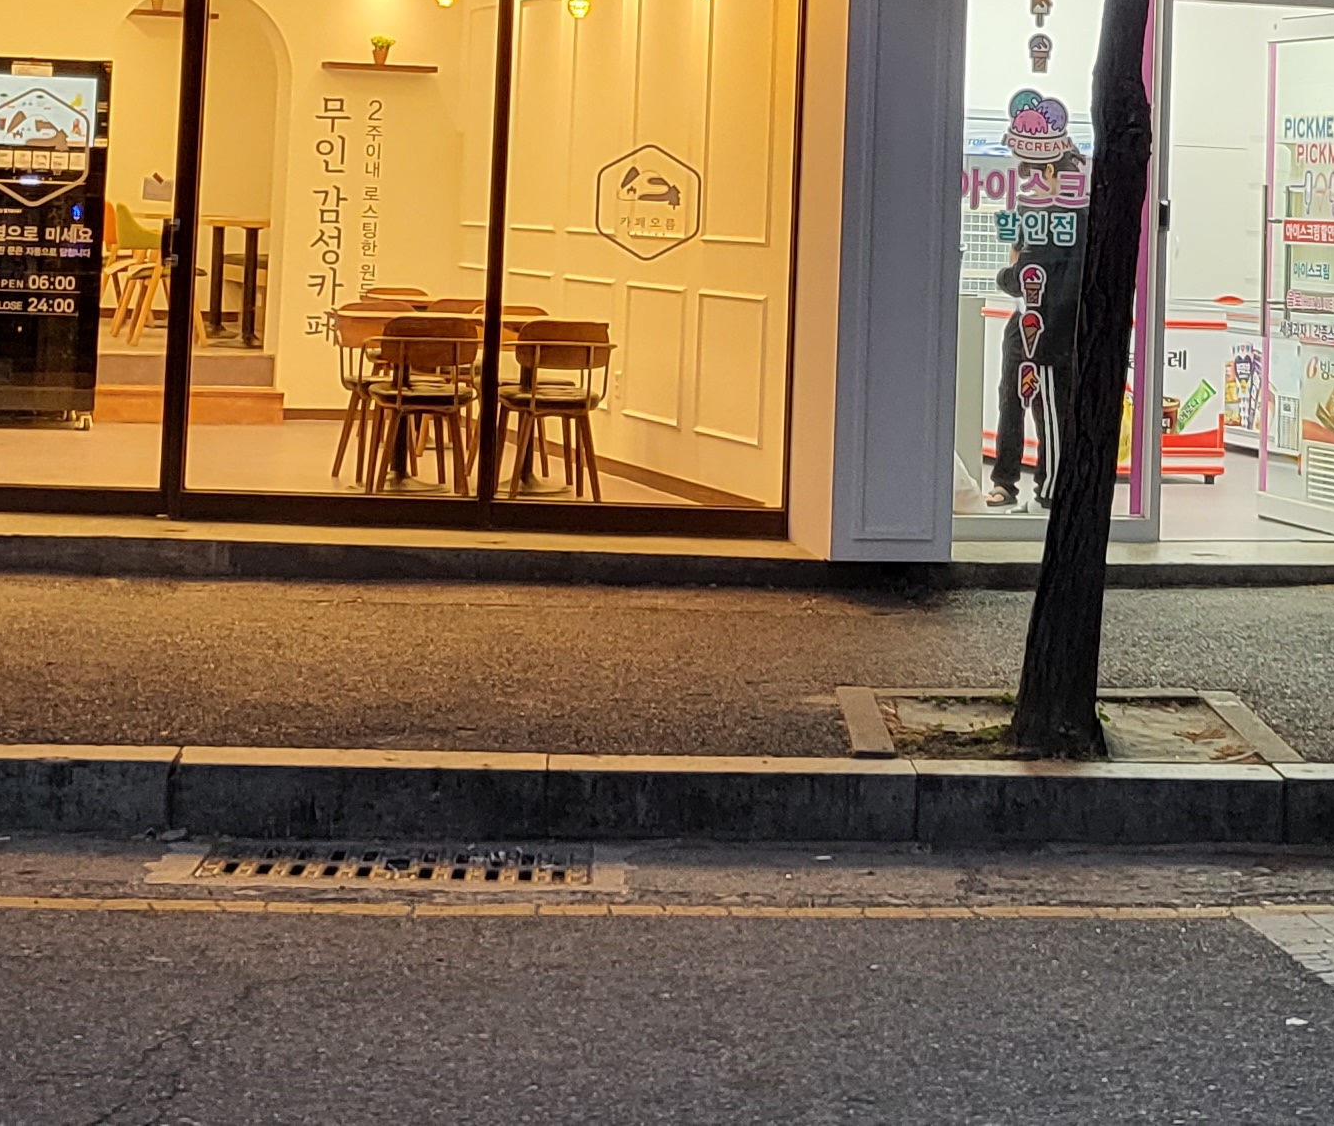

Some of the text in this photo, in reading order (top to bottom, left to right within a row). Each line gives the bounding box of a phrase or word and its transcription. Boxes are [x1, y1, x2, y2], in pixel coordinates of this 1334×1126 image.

[314, 97, 352, 173] 무인
[365, 99, 383, 178] 2주이내
[1284, 114, 1334, 140] PICKME
[961, 168, 1090, 210] 아이스크
[45, 226, 94, 243] 미세요
[361, 186, 381, 257] 로스팅한
[996, 211, 1077, 245] 할인점
[28, 274, 77, 291] 06:00
[27, 296, 75, 313] 24:00
